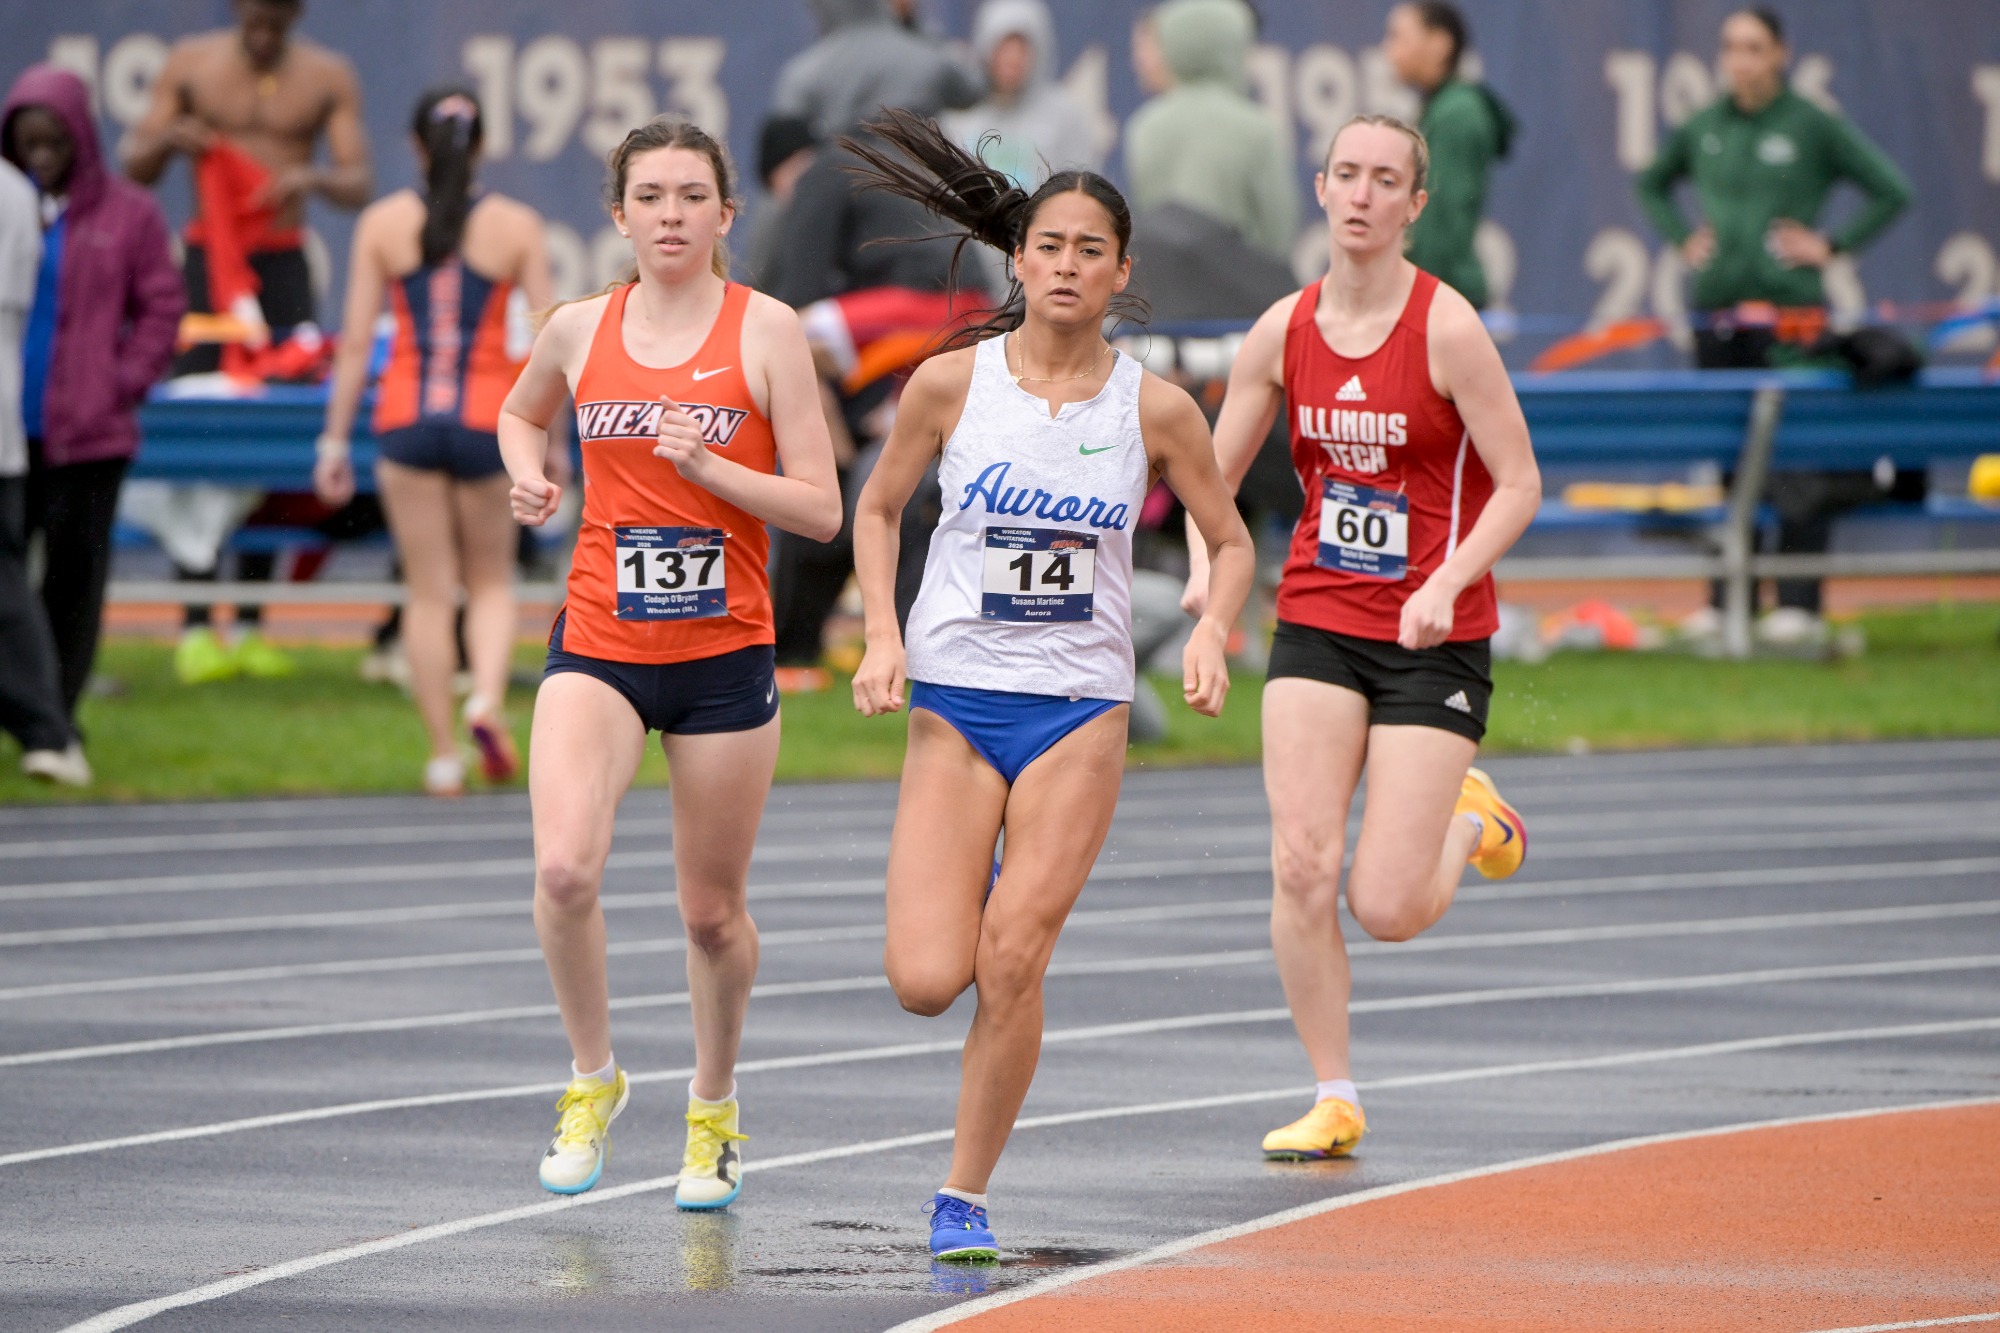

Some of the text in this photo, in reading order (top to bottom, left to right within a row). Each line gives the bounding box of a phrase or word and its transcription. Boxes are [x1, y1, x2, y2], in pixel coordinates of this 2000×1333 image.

[1299, 404, 1407, 446] ILLINOIS
[1320, 441, 1388, 474] TECH
[959, 462, 1128, 530] Aurora
[1337, 508, 1389, 549] 60
[624, 549, 721, 590] 137
[1009, 552, 1075, 591] 14
[1011, 596, 1036, 606] Susana
